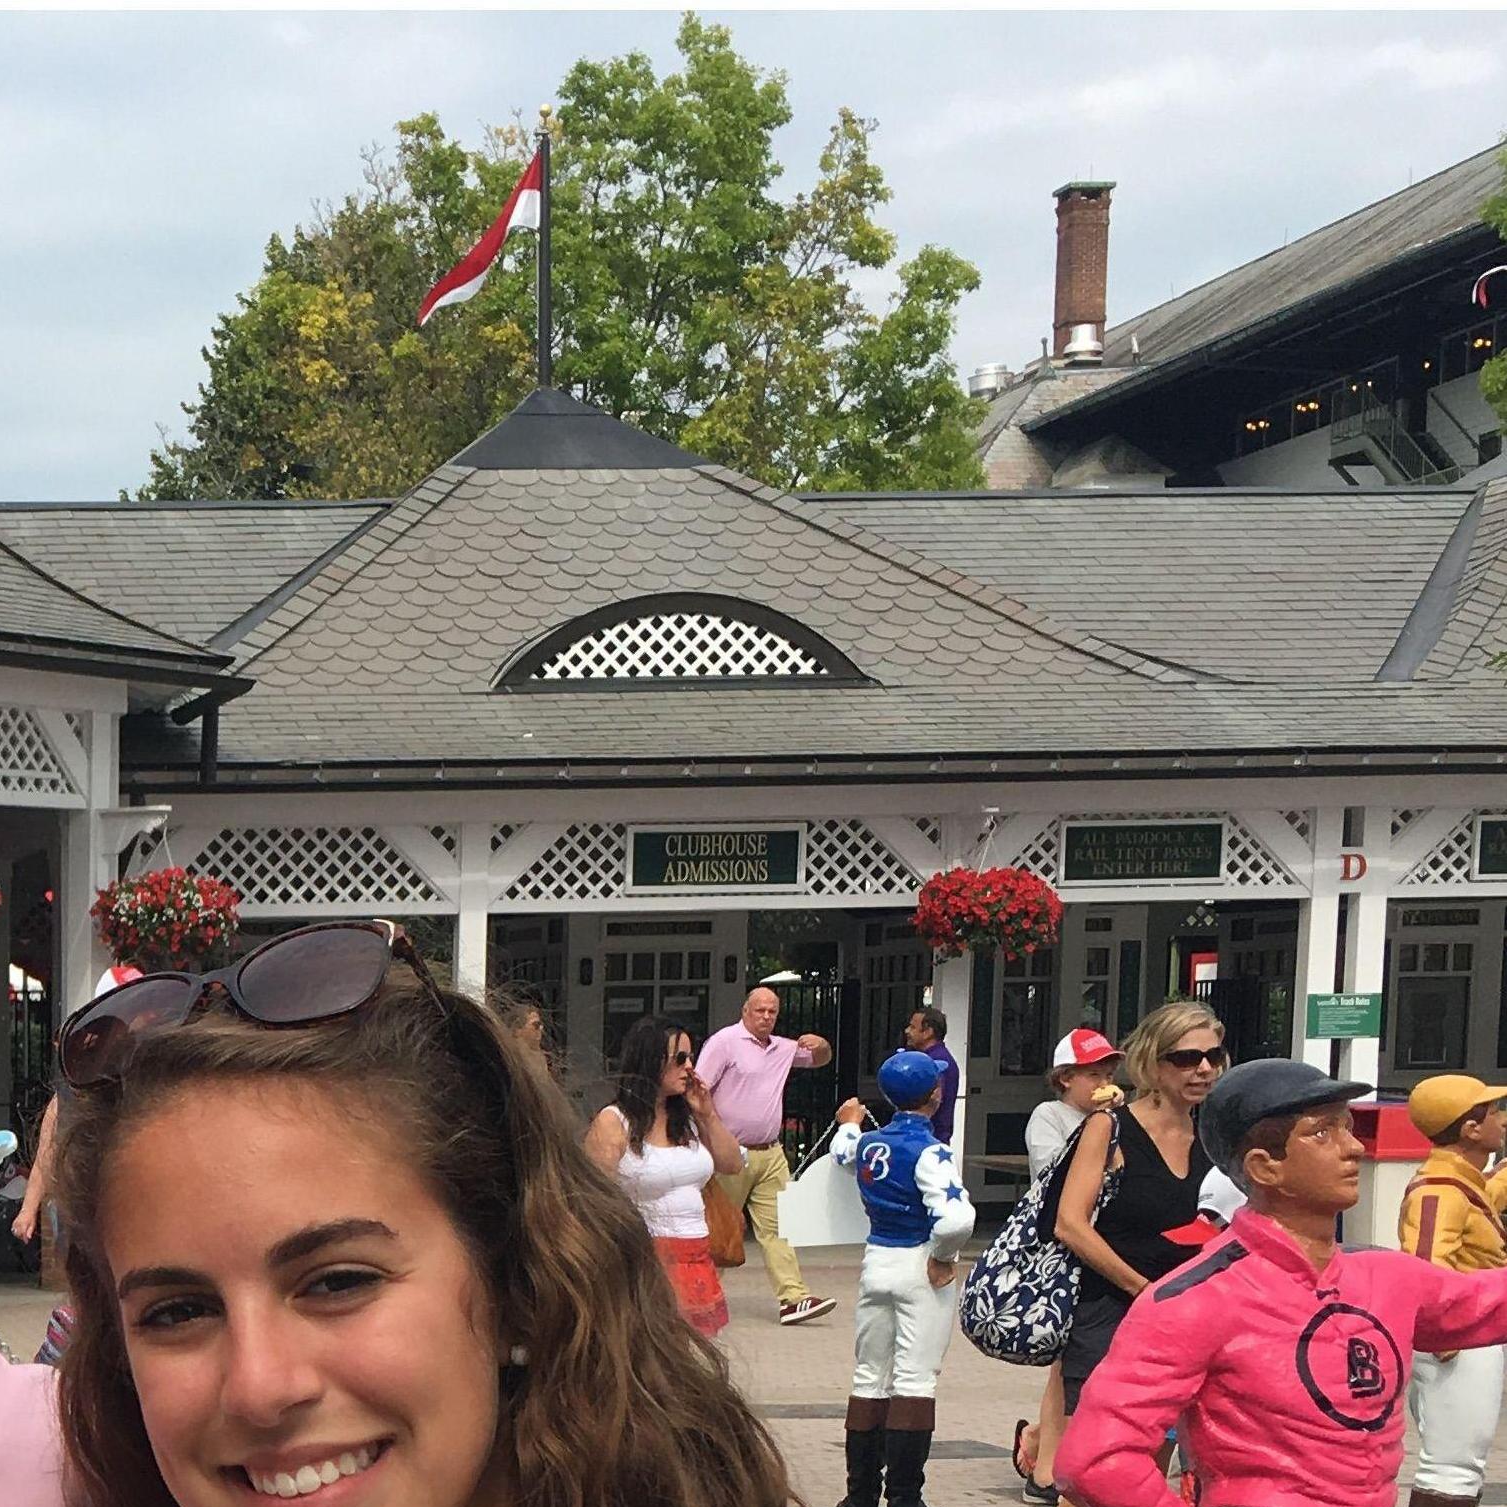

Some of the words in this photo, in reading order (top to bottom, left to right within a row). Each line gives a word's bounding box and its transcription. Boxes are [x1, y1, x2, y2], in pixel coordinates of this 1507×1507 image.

[665, 834, 768, 857] CLUBHOUSE
[1074, 848, 1109, 861] RAIL
[1117, 848, 1159, 860] TENT
[662, 859, 769, 883] ADMISSIONS
[1093, 862, 1145, 875] ENTER
[1151, 861, 1191, 874] HERE
[1340, 853, 1367, 881] D
[862, 1142, 891, 1181] B
[1347, 1337, 1386, 1399] B
